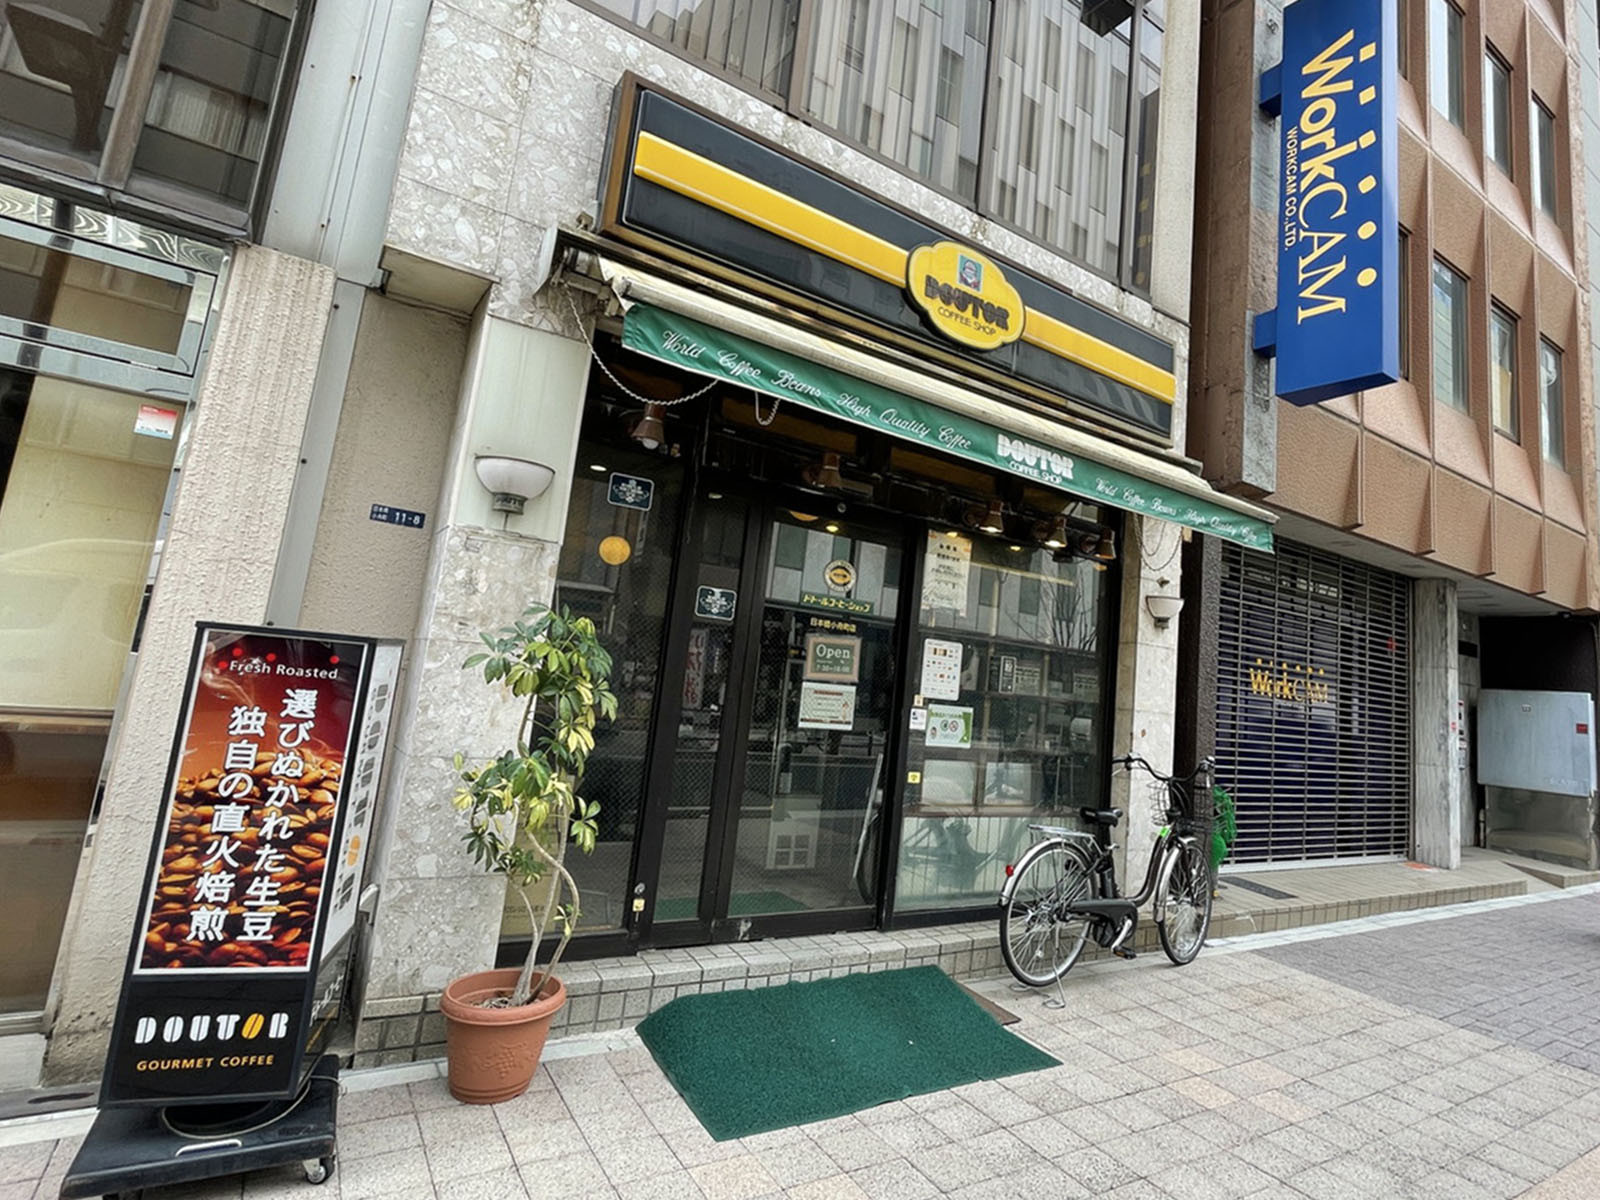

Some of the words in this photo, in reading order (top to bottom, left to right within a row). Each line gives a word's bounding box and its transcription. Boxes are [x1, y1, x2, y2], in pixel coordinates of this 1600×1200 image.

[1286, 125, 1298, 195] WORKCAM
[1298, 29, 1356, 324] WorkCAM
[924, 274, 1010, 331] DOUTOR
[937, 306, 972, 327] COFFEE
[973, 320, 996, 335] SHOP
[662, 330, 706, 359] World
[717, 348, 762, 379] Coffee
[770, 368, 822, 397] Beans
[836, 391, 872, 418] High
[879, 407, 931, 439] Quality
[938, 425, 974, 450] Coffee
[997, 433, 1074, 480] DOUTOR
[1009, 460, 1041, 477] COFFEE
[1041, 472, 1062, 484] SHOP
[395, 512, 420, 525] 11-8
[229, 660, 271, 675] Fresh
[276, 664, 338, 680] Roasted
[816, 644, 850, 659] Open
[186, 706, 267, 942] 独自の直火焙煎
[236, 688, 318, 941] 選びぬかれた生豆
[134, 1012, 289, 1044] DOUTOR
[136, 1057, 214, 1071] GOURMET
[220, 1054, 275, 1068] COFFEE
